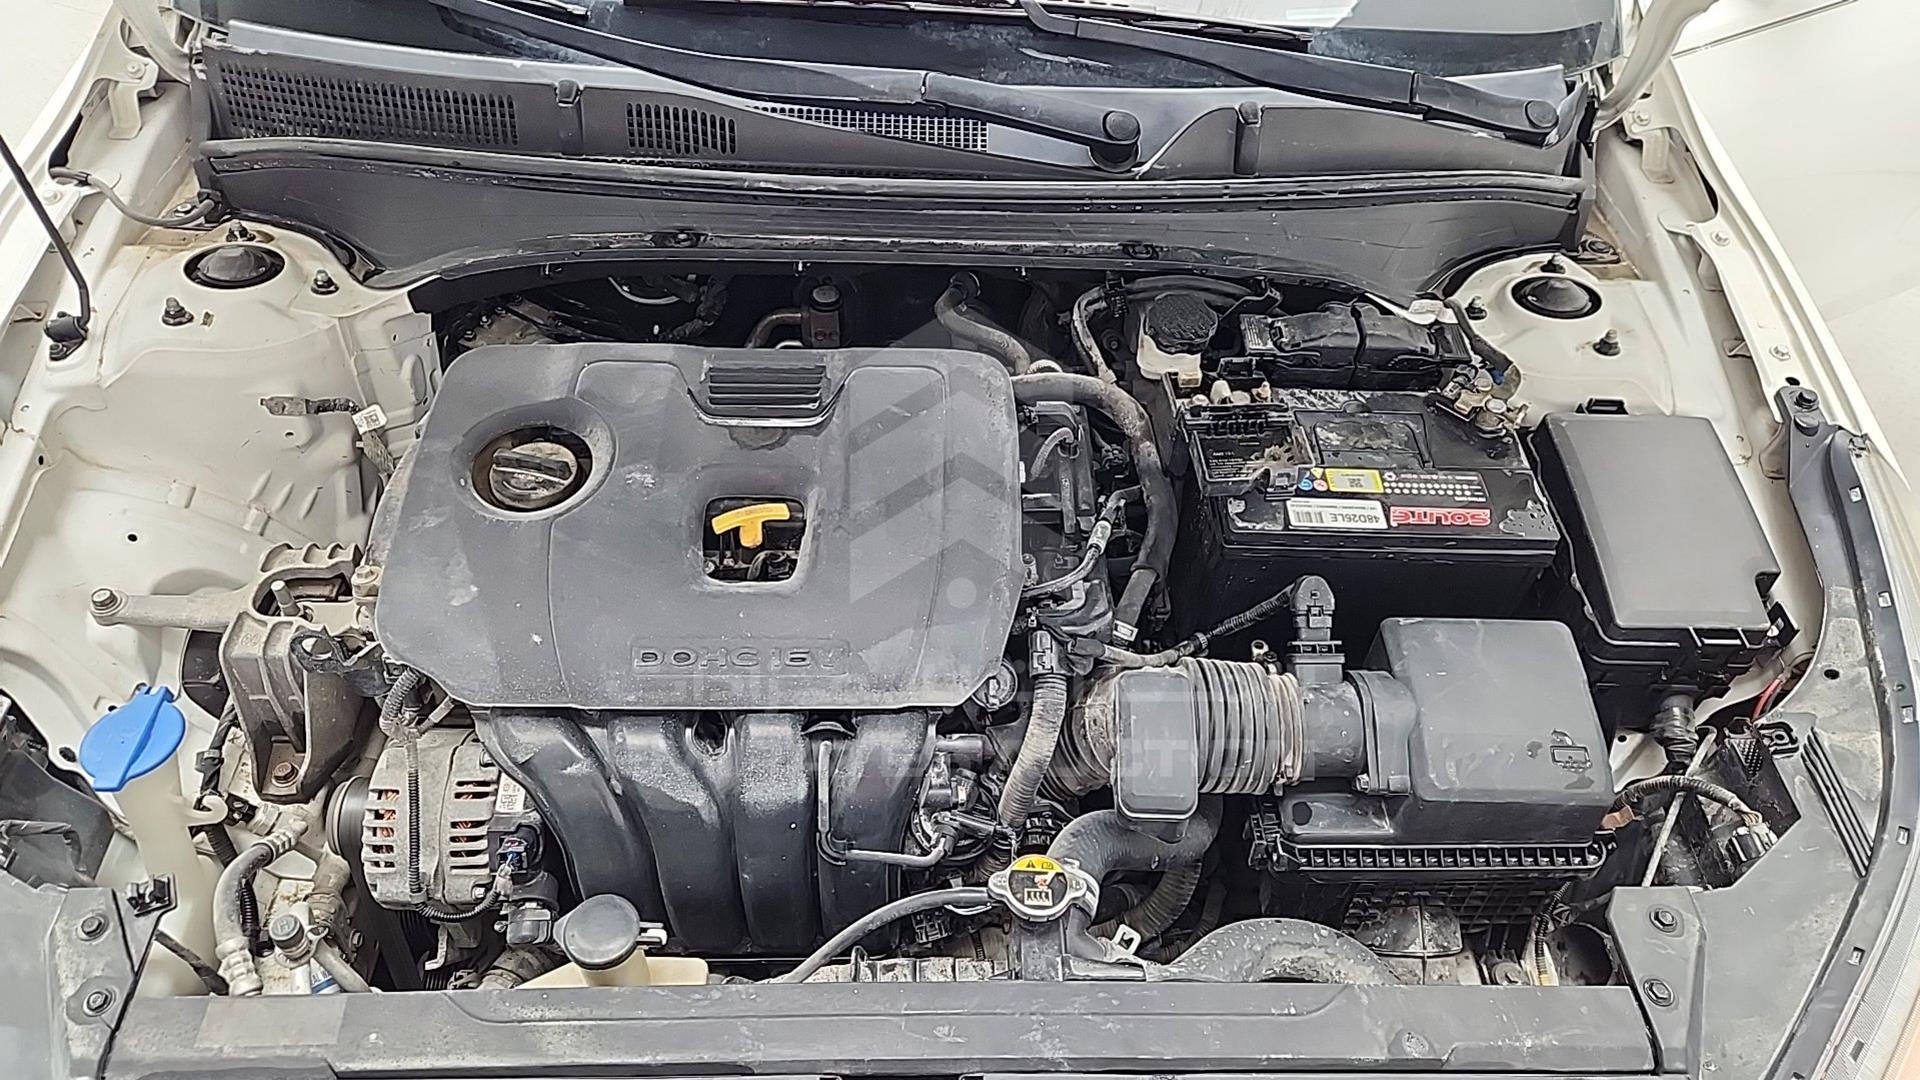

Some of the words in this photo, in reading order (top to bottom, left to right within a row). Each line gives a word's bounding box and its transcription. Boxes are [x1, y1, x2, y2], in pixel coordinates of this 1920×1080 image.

[1330, 512, 1380, 524] 48D26LE
[1391, 507, 1490, 526] SOLITE
[634, 646, 760, 669] DOHC
[770, 646, 845, 669] 16V
